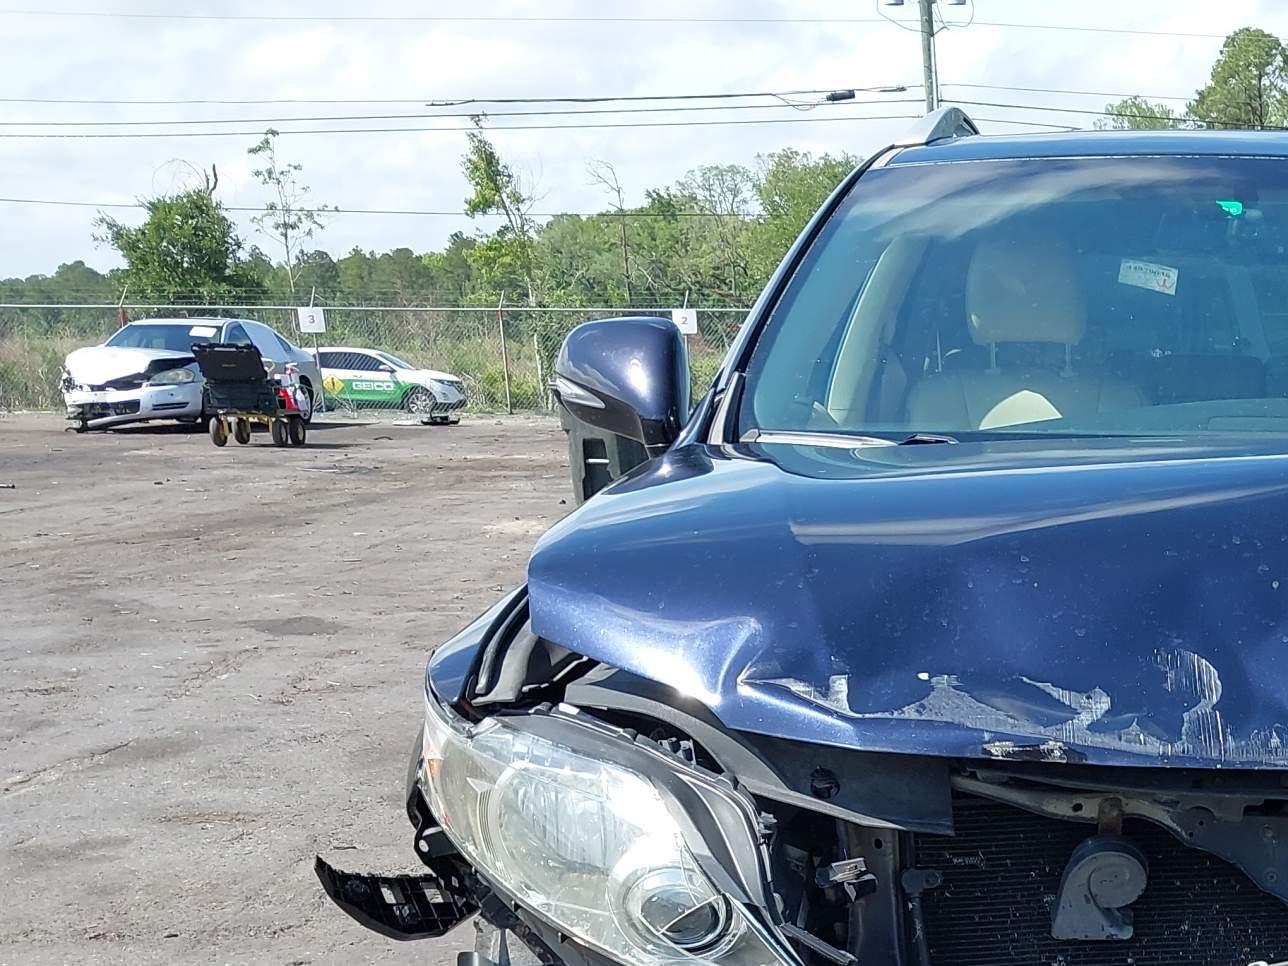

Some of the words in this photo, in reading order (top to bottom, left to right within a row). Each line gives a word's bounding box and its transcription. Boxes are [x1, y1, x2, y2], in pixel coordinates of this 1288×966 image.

[307, 314, 316, 324] 3
[680, 316, 688, 325] 2
[352, 381, 395, 391] GEICO
